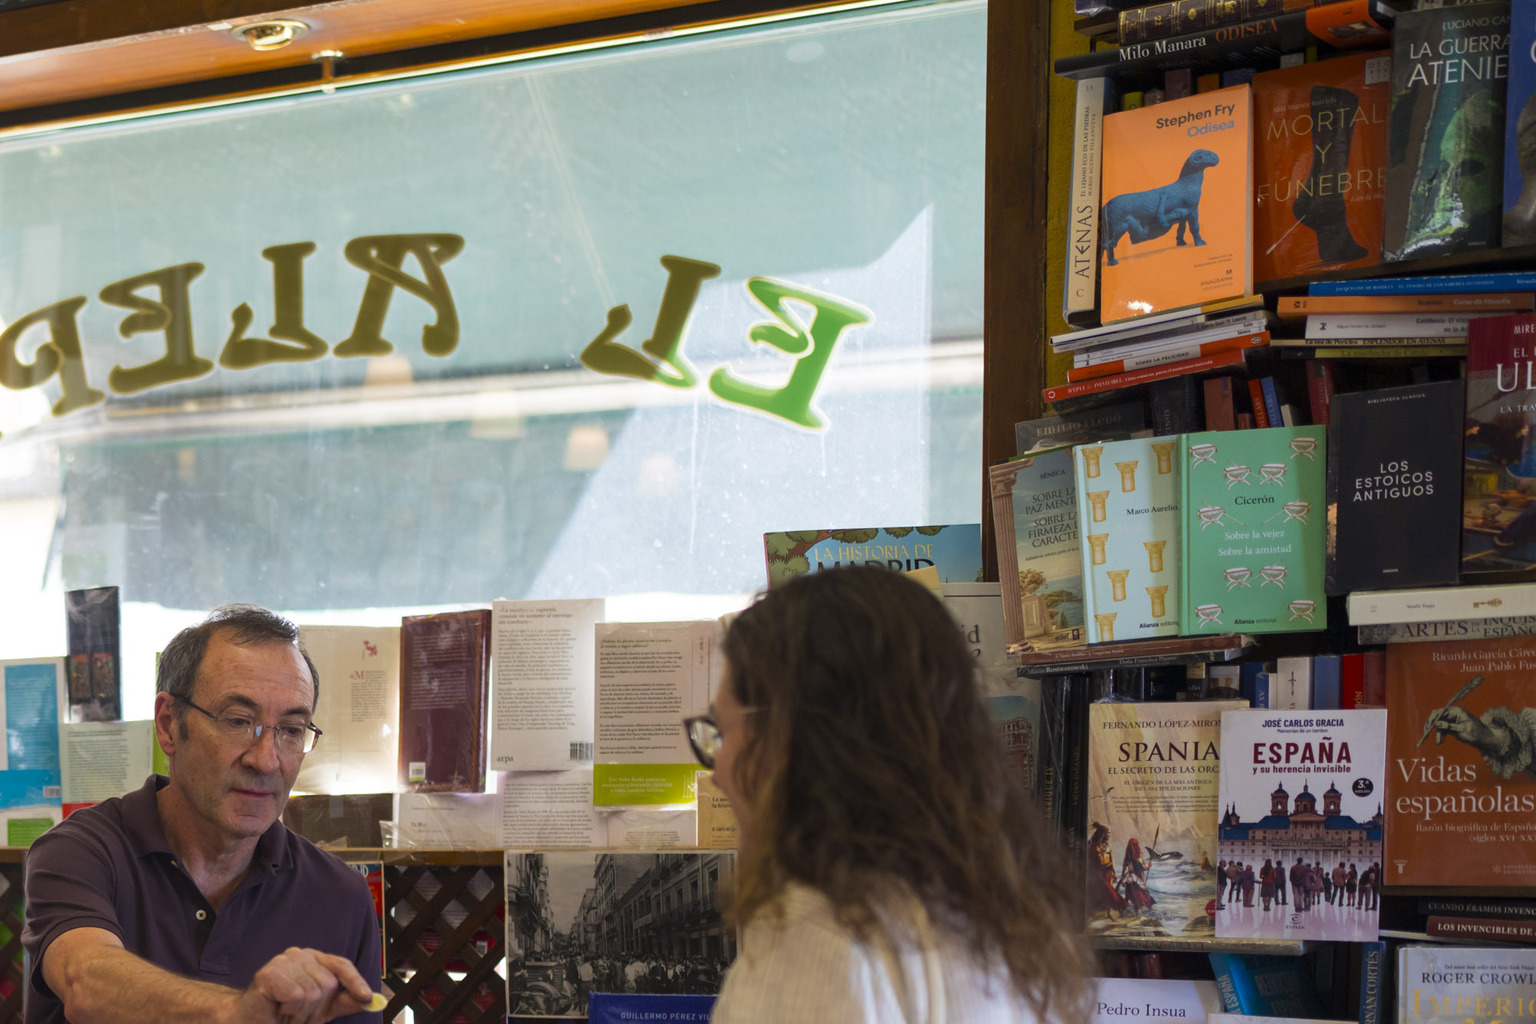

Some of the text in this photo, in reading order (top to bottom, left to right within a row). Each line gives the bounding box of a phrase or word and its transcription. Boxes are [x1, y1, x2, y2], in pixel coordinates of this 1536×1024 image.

[1119, 18, 1278, 62] Milo Manara ODISEA
[1156, 103, 1235, 130] Stephen Fry
[1267, 103, 1385, 141] MORTAL
[1187, 120, 1235, 137] Odisea
[1316, 143, 1332, 164] Y
[1074, 204, 1092, 279] ATENAS
[1363, 337, 1405, 345] ESPLENDOR
[1380, 460, 1409, 474] LOS
[1355, 471, 1434, 490] ESTOICOS
[1235, 495, 1275, 506] Cicerón
[1352, 484, 1434, 503] ANTIGUOS
[814, 543, 934, 562] LA HISTORIA DE
[1102, 720, 1156, 730] FERNANDO
[1262, 718, 1345, 728] JOSÉ CARLOS GRACIA
[496, 753, 514, 766] arpa
[1118, 741, 1220, 763] SPANIA
[1253, 736, 1352, 764] ESPAÑA
[1396, 756, 1477, 783] Vidas
[1396, 786, 1535, 821] españolas
[1367, 950, 1379, 993] CORTÉS
[1421, 972, 1475, 984] ROGER
[621, 1011, 696, 1020] GUILLERMO PÉREZ
[1097, 1002, 1187, 1018] Pedro Insua
